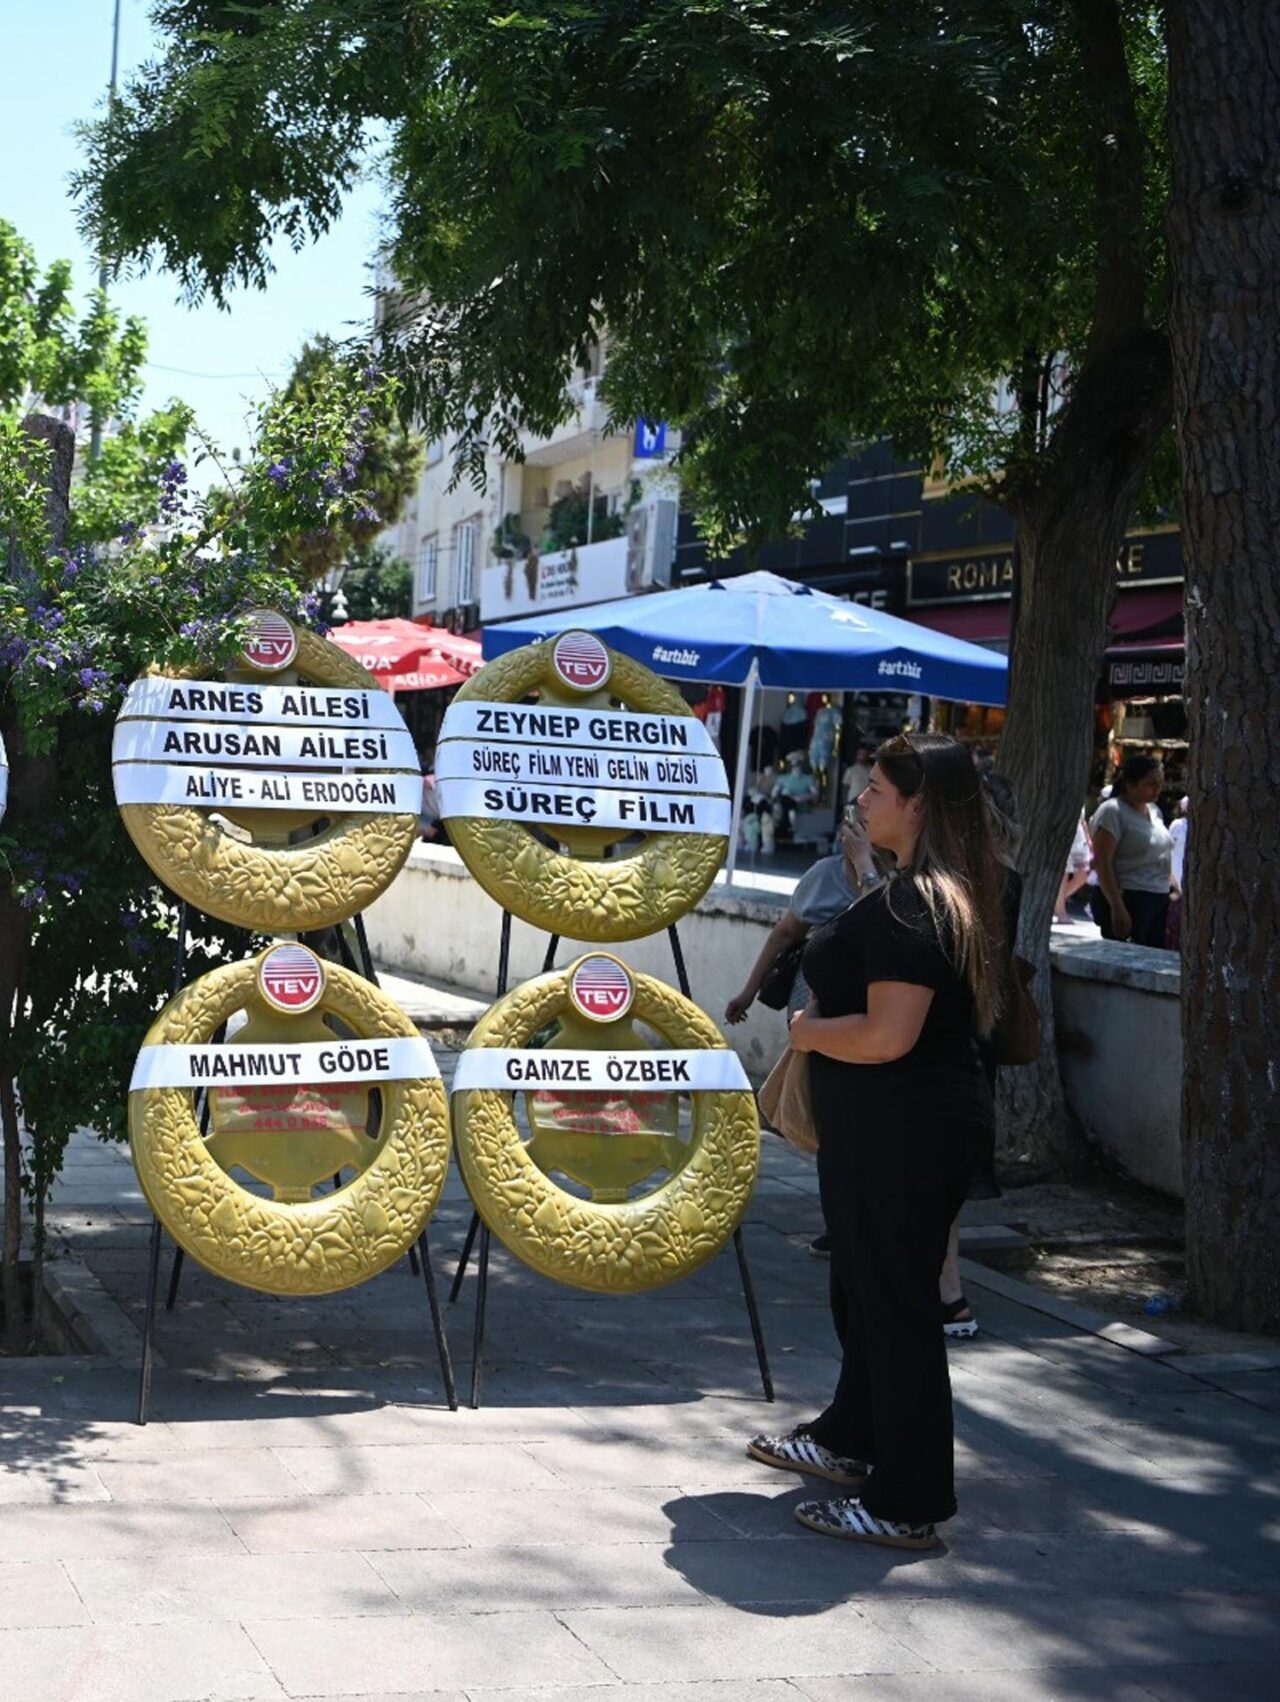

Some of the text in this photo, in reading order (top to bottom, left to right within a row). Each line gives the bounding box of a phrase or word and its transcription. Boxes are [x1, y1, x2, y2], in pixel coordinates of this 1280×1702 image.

[245, 641, 290, 655] TEV
[560, 660, 603, 677] TEV
[168, 688, 369, 719] ARNES AİLESİ
[476, 709, 687, 746] ZEYNEP GERGİN
[163, 731, 388, 760] ARUSAN AİLESİ
[472, 747, 699, 785] SÜREÇ FİLM YENİ GELİN DİZİSİ
[185, 771, 243, 799] ALİYE
[260, 775, 291, 801] ALİ
[302, 778, 396, 805] ERDOĞAN
[484, 787, 696, 825] SÜREÇ FİLM
[268, 979, 317, 995] TEV
[578, 989, 626, 1005] TEV
[189, 1046, 390, 1078] MAHMUT GÖDE
[506, 1055, 691, 1082] GAMZE ÖZBEK
